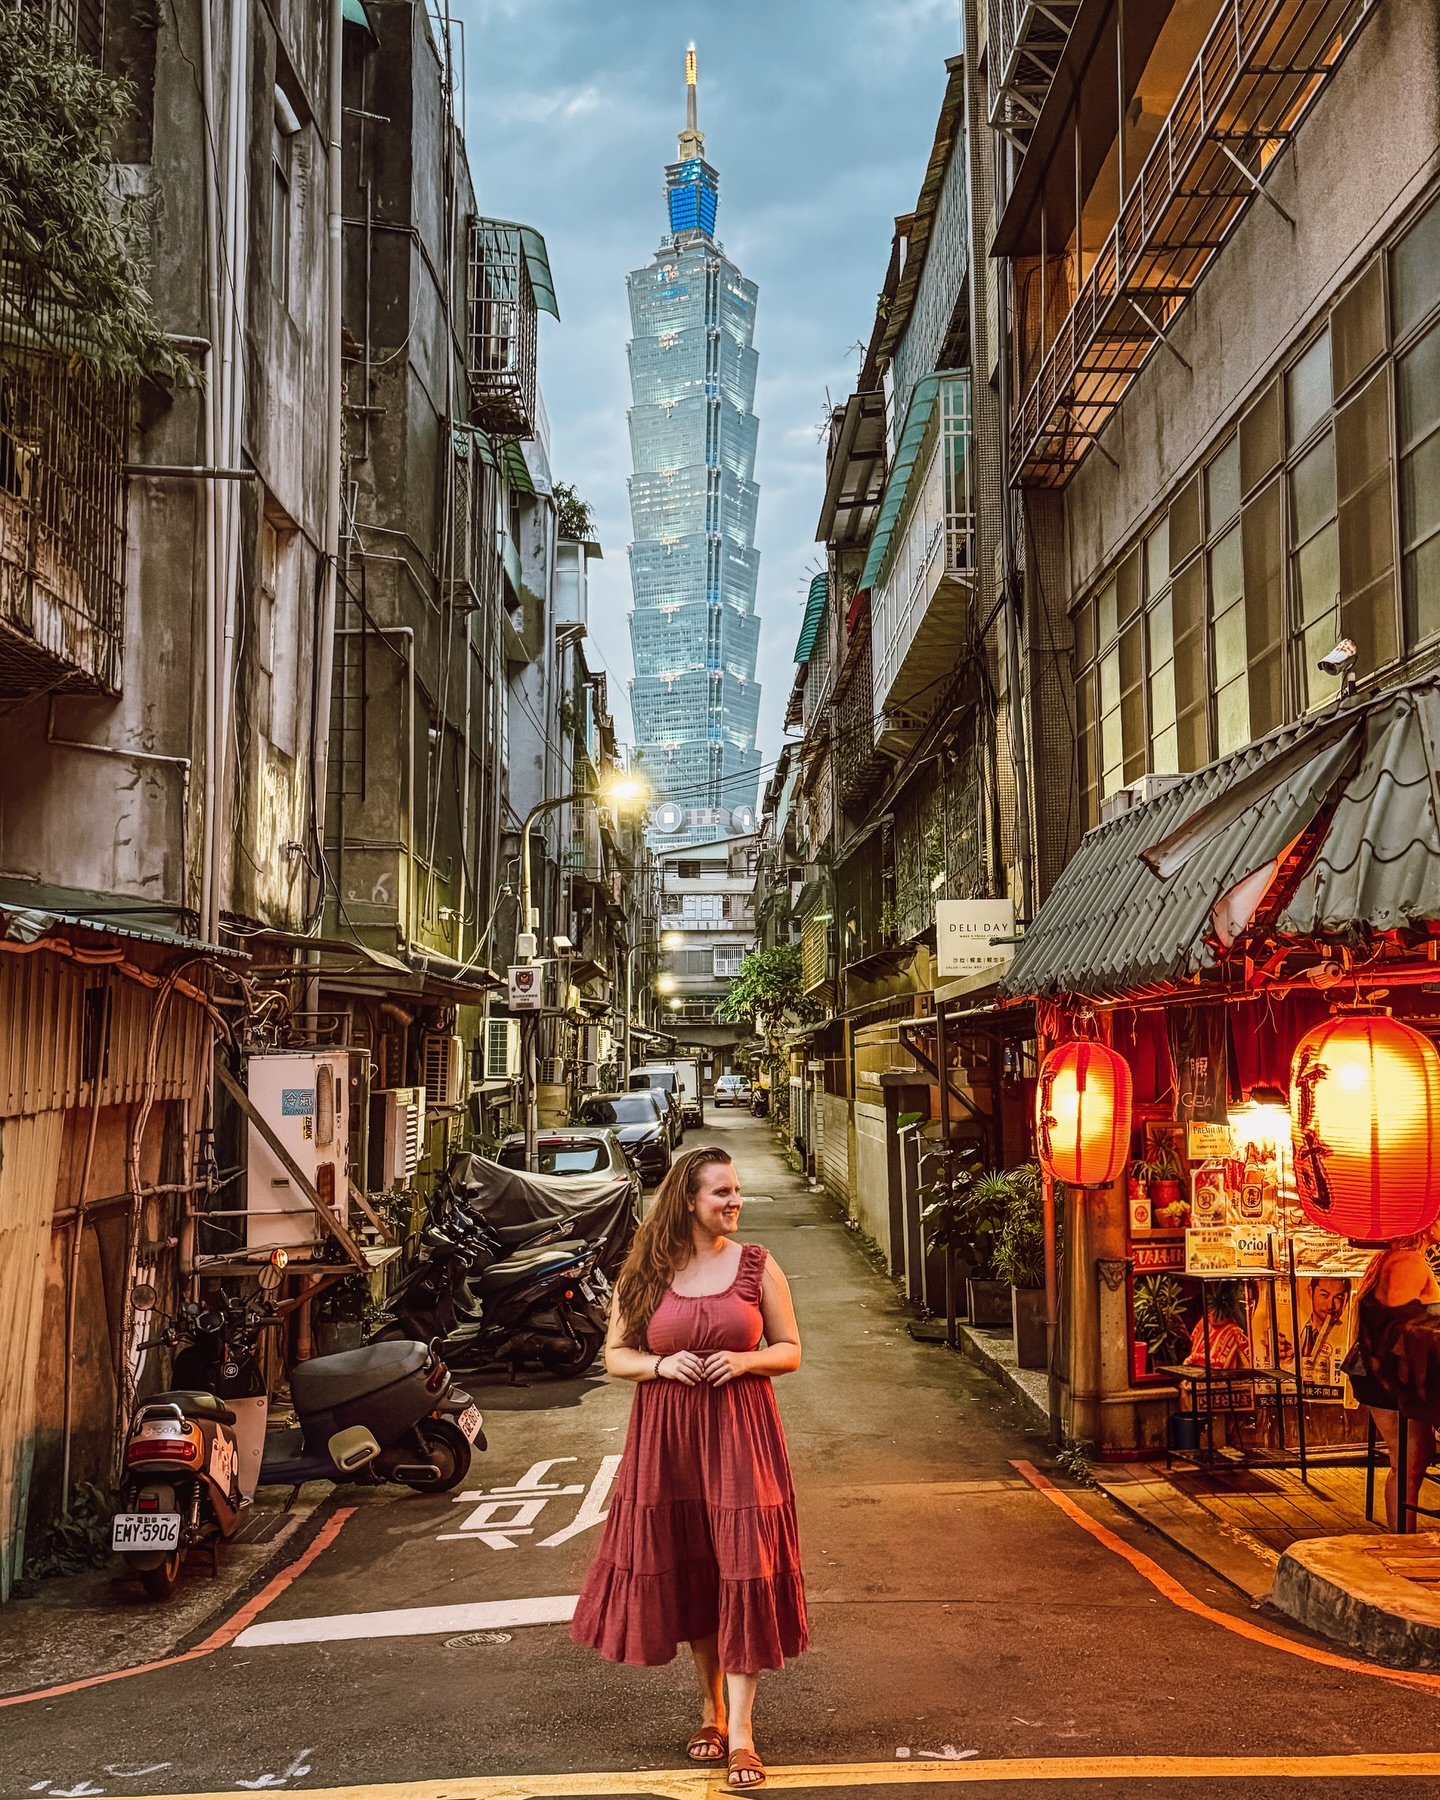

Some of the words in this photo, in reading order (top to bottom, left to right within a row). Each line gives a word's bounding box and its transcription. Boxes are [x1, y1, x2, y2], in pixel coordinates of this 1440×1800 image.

[949, 923, 977, 932] DELI
[983, 923, 1008, 932] DAY
[284, 1091, 313, 1107] 冷氣
